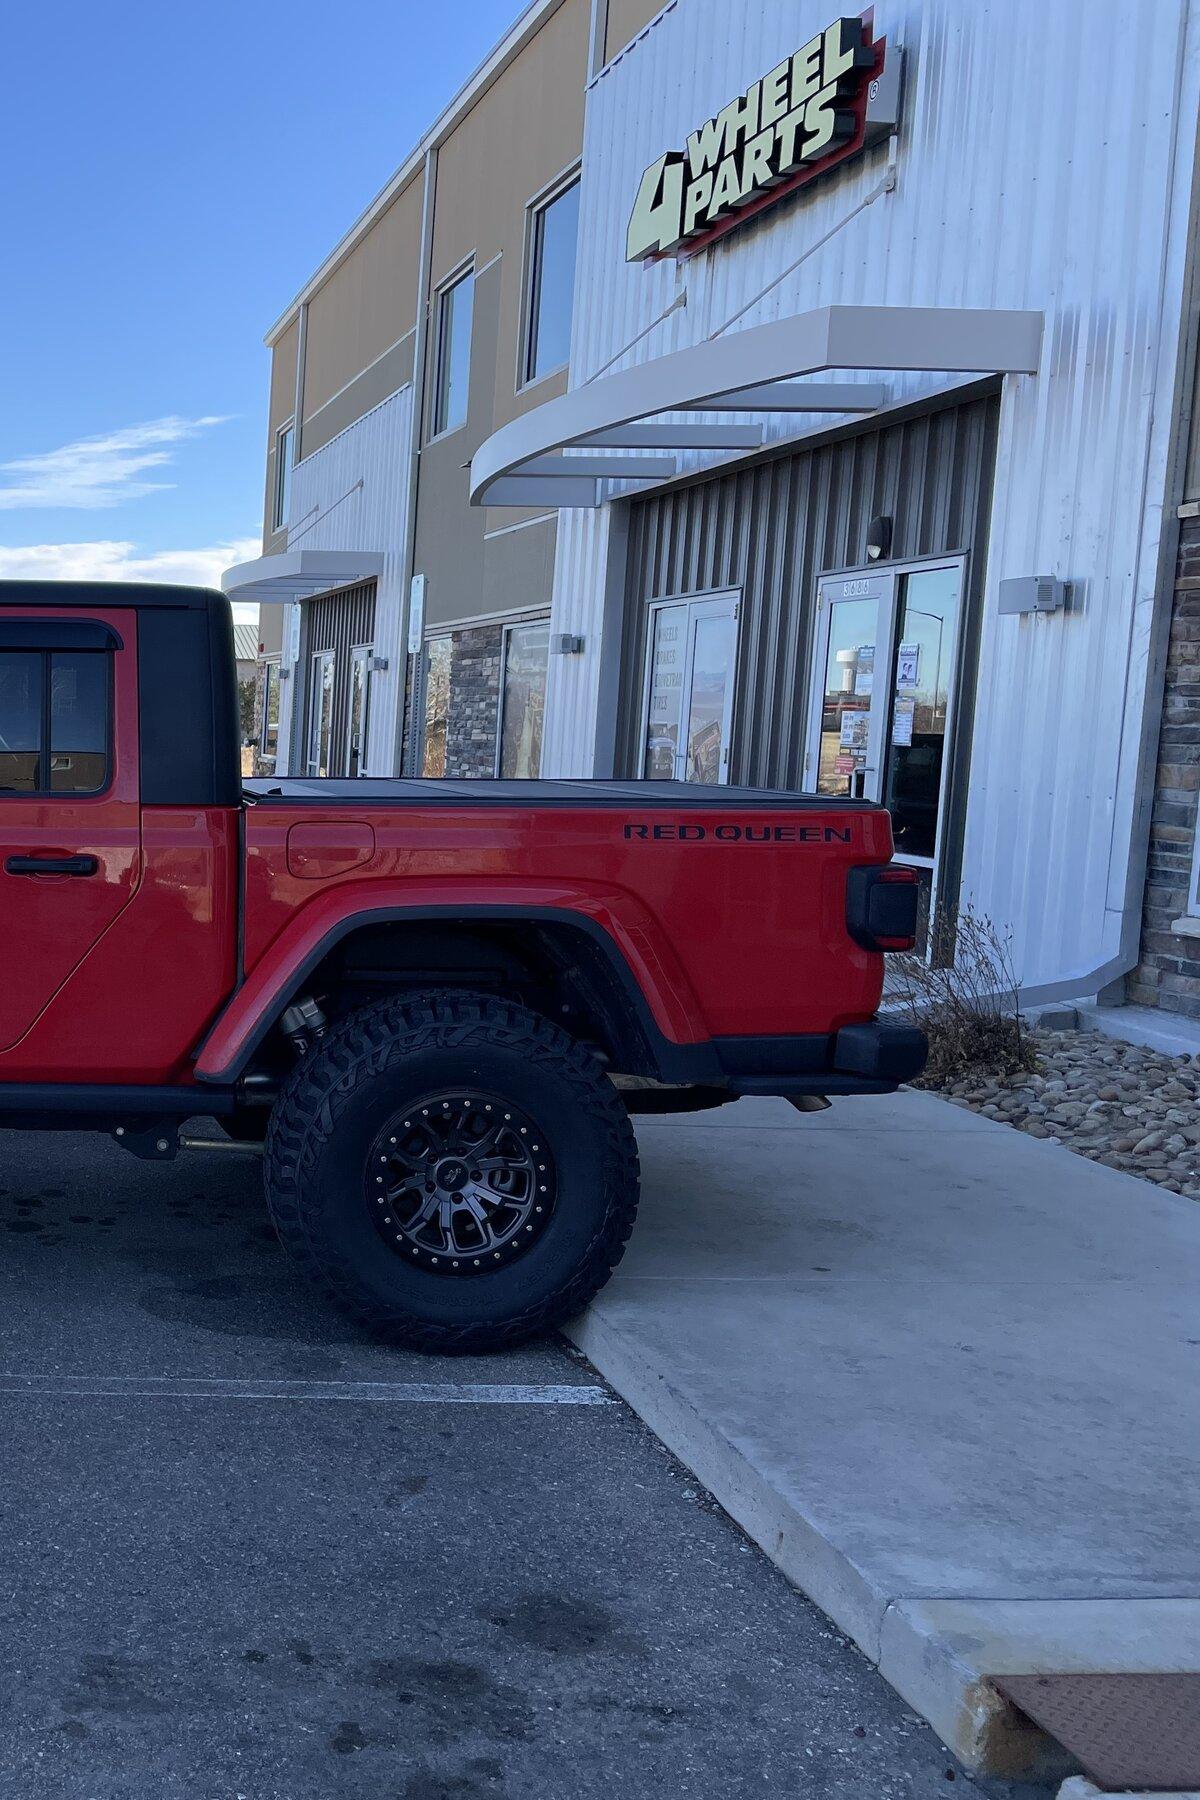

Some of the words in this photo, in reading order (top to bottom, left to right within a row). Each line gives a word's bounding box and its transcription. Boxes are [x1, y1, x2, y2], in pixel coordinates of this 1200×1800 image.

[626, 152, 685, 262] 4
[686, 18, 854, 179] WHEEL
[683, 80, 838, 237] PARTS
[623, 824, 706, 840] RED
[715, 825, 851, 842] QUEEN
